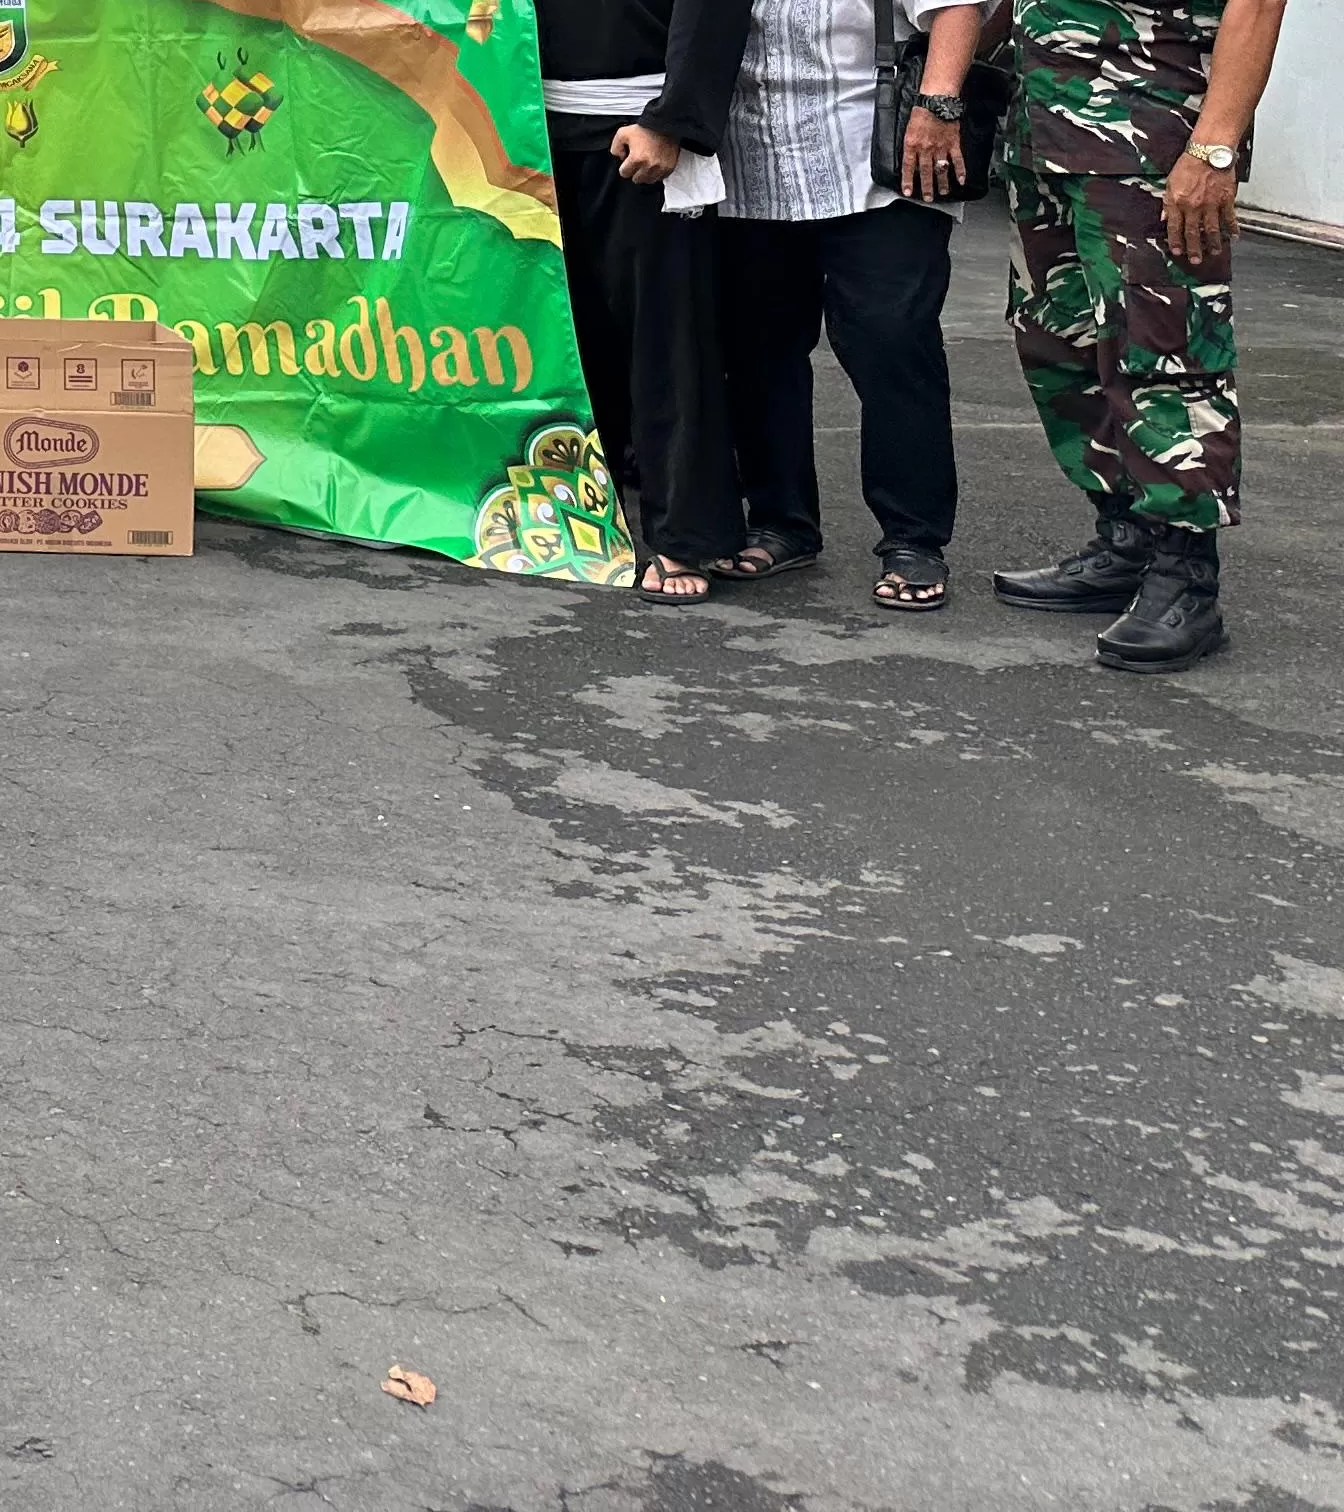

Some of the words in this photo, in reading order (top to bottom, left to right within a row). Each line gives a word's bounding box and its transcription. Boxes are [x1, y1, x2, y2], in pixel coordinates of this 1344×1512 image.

[38, 200, 410, 261] SURAKARTA
[16, 431, 88, 455] Monde
[59, 473, 149, 497] MONDE
[51, 498, 128, 510] COOKIES
